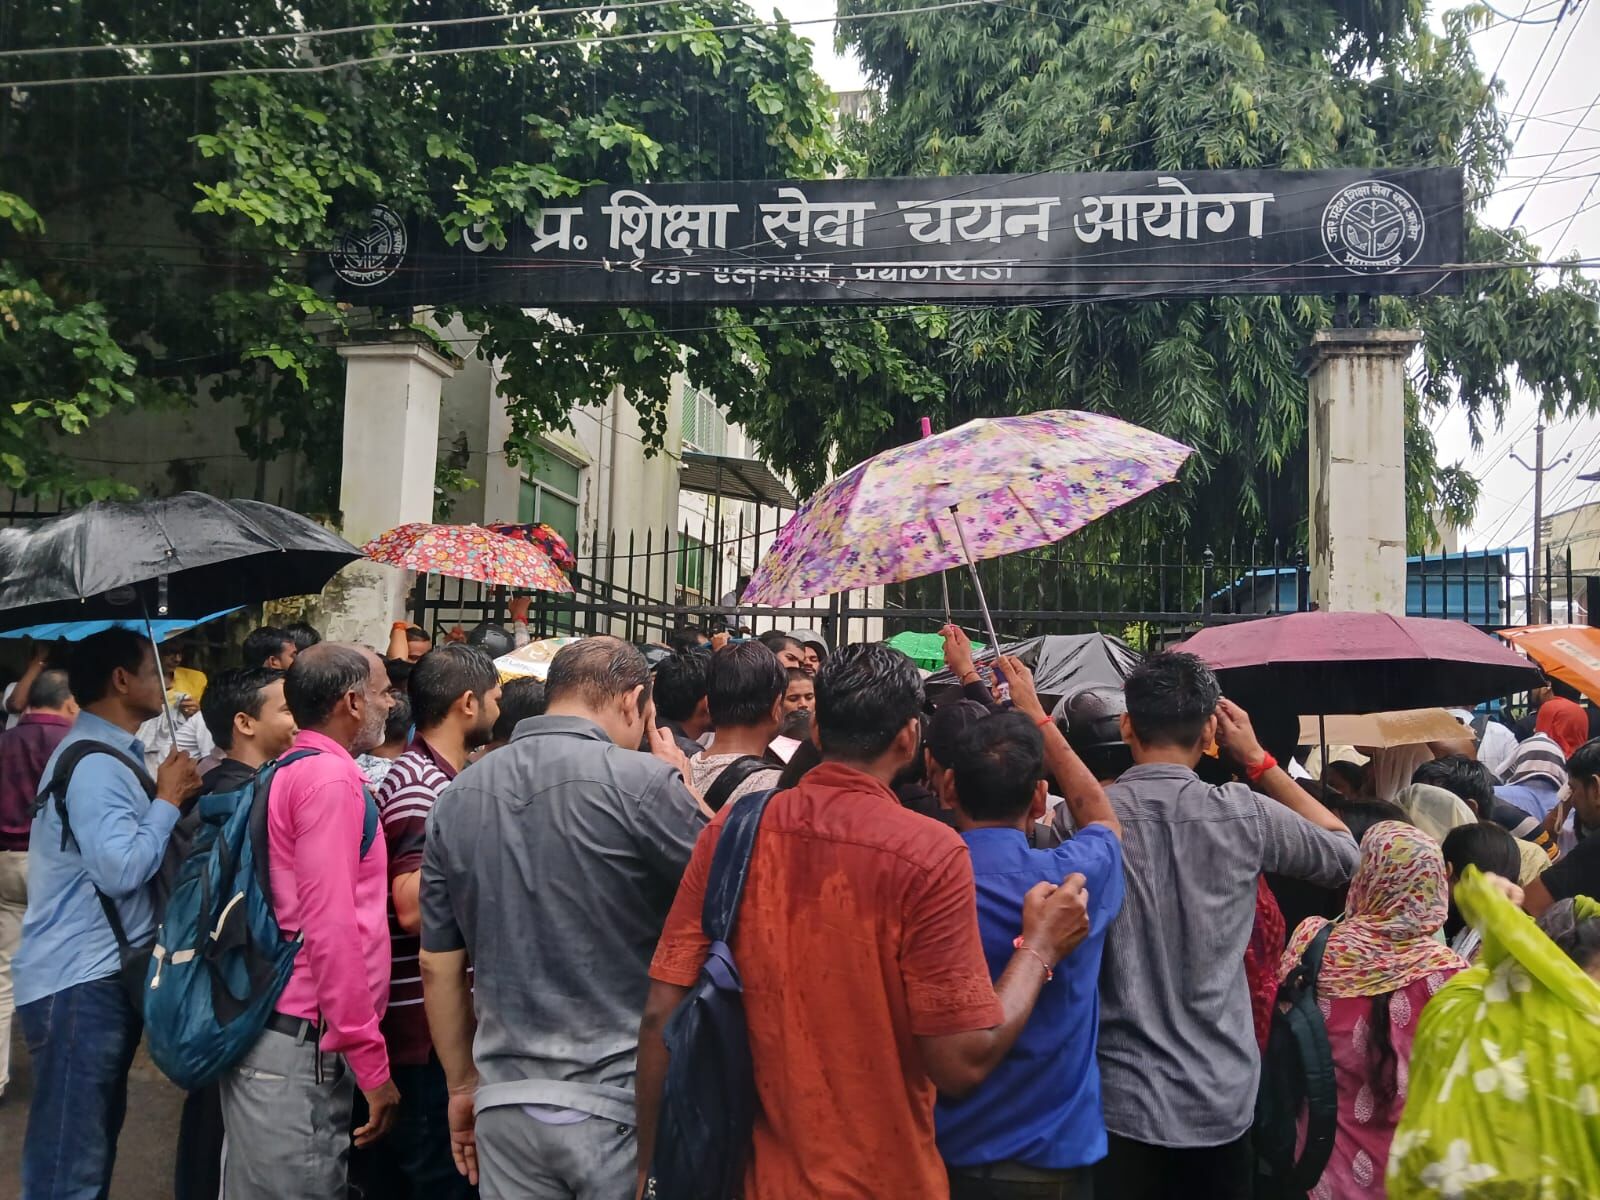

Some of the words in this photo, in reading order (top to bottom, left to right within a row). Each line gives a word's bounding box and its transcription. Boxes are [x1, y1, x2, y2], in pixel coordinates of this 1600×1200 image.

[530, 206, 588, 253] प्र.
[601, 189, 739, 259] शिक्षा
[759, 187, 877, 248] सेवा
[897, 196, 1060, 245] चयन
[1073, 176, 1276, 243] आयोग
